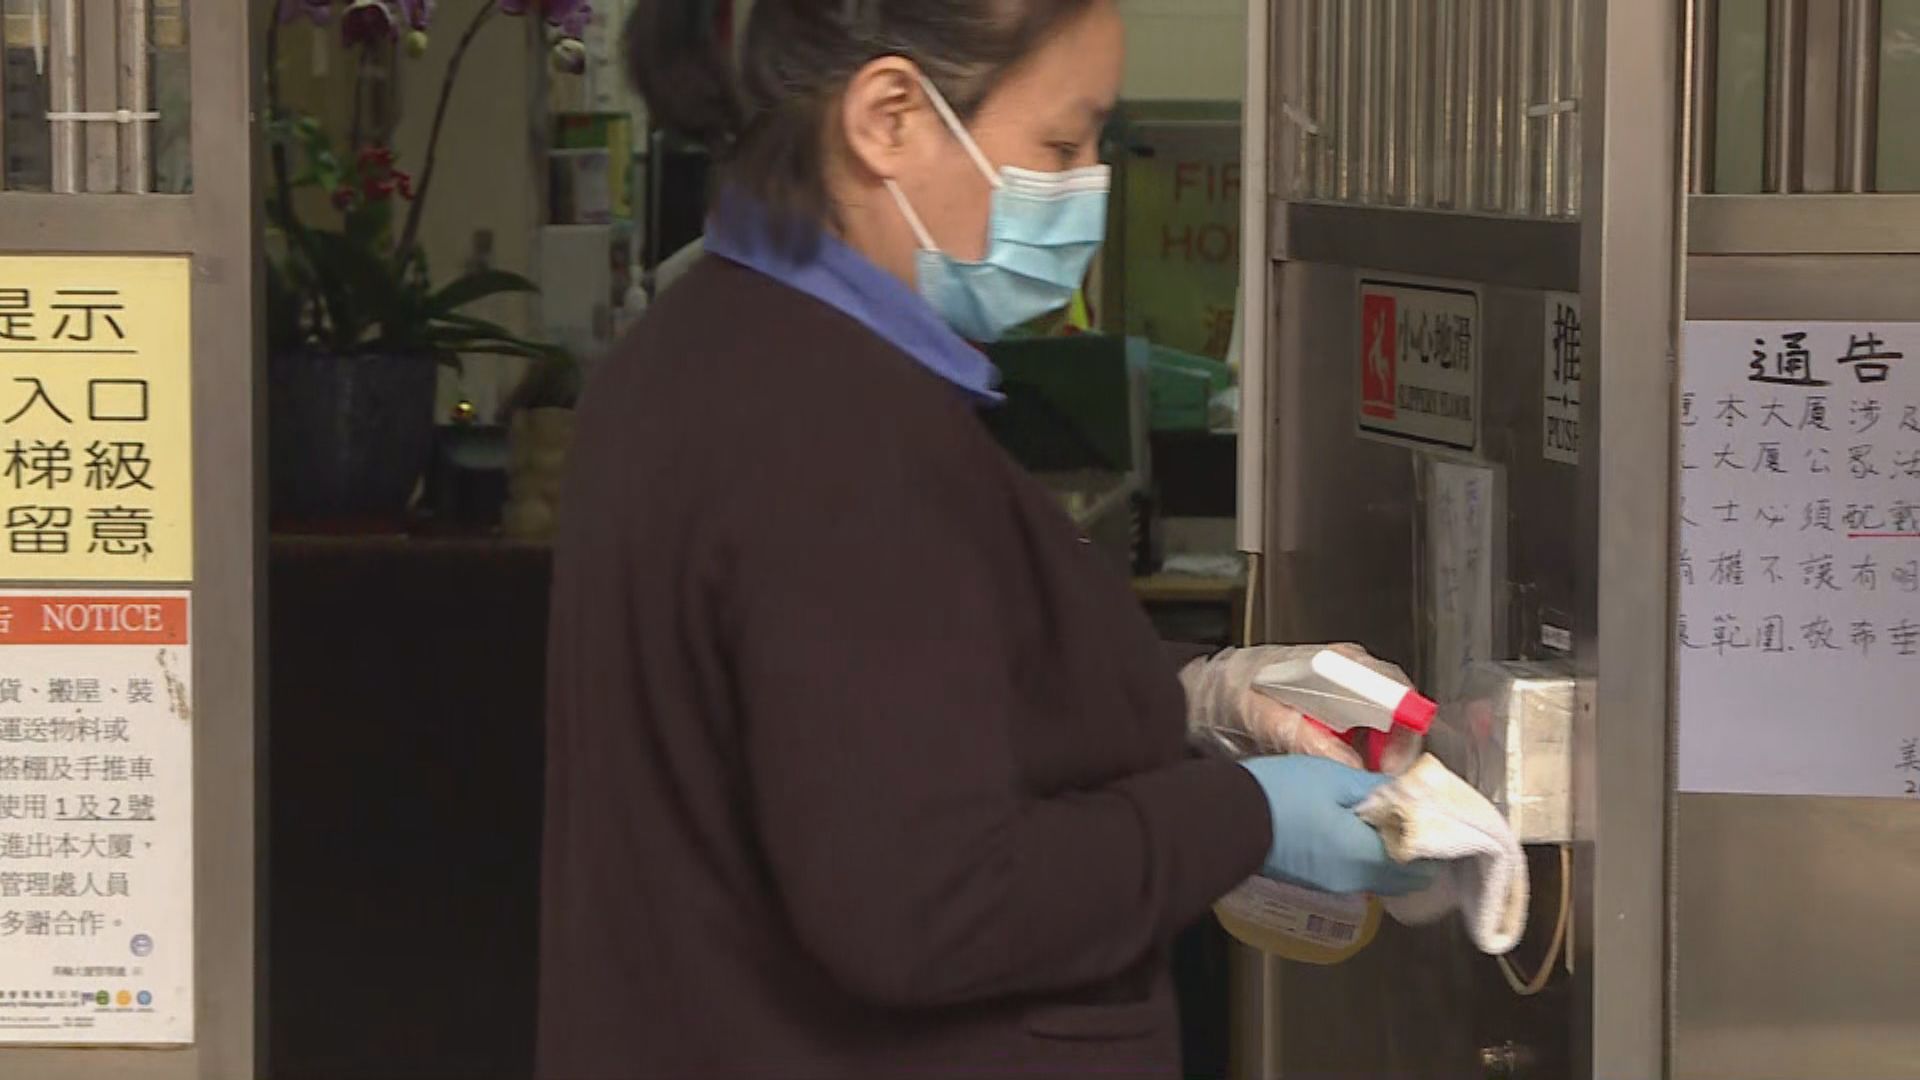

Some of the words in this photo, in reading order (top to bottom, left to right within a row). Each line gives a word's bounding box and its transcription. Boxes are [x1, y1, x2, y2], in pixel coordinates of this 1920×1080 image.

[1161, 223, 1237, 263] HO
[1553, 302, 1581, 385] 推
[1748, 332, 1903, 387] 通告
[3, 377, 149, 423] 入口
[3, 439, 155, 491] 梯級
[5, 504, 154, 555] 留意
[43, 603, 164, 632] NOTICE
[0, 872, 130, 897] 管理處人員
